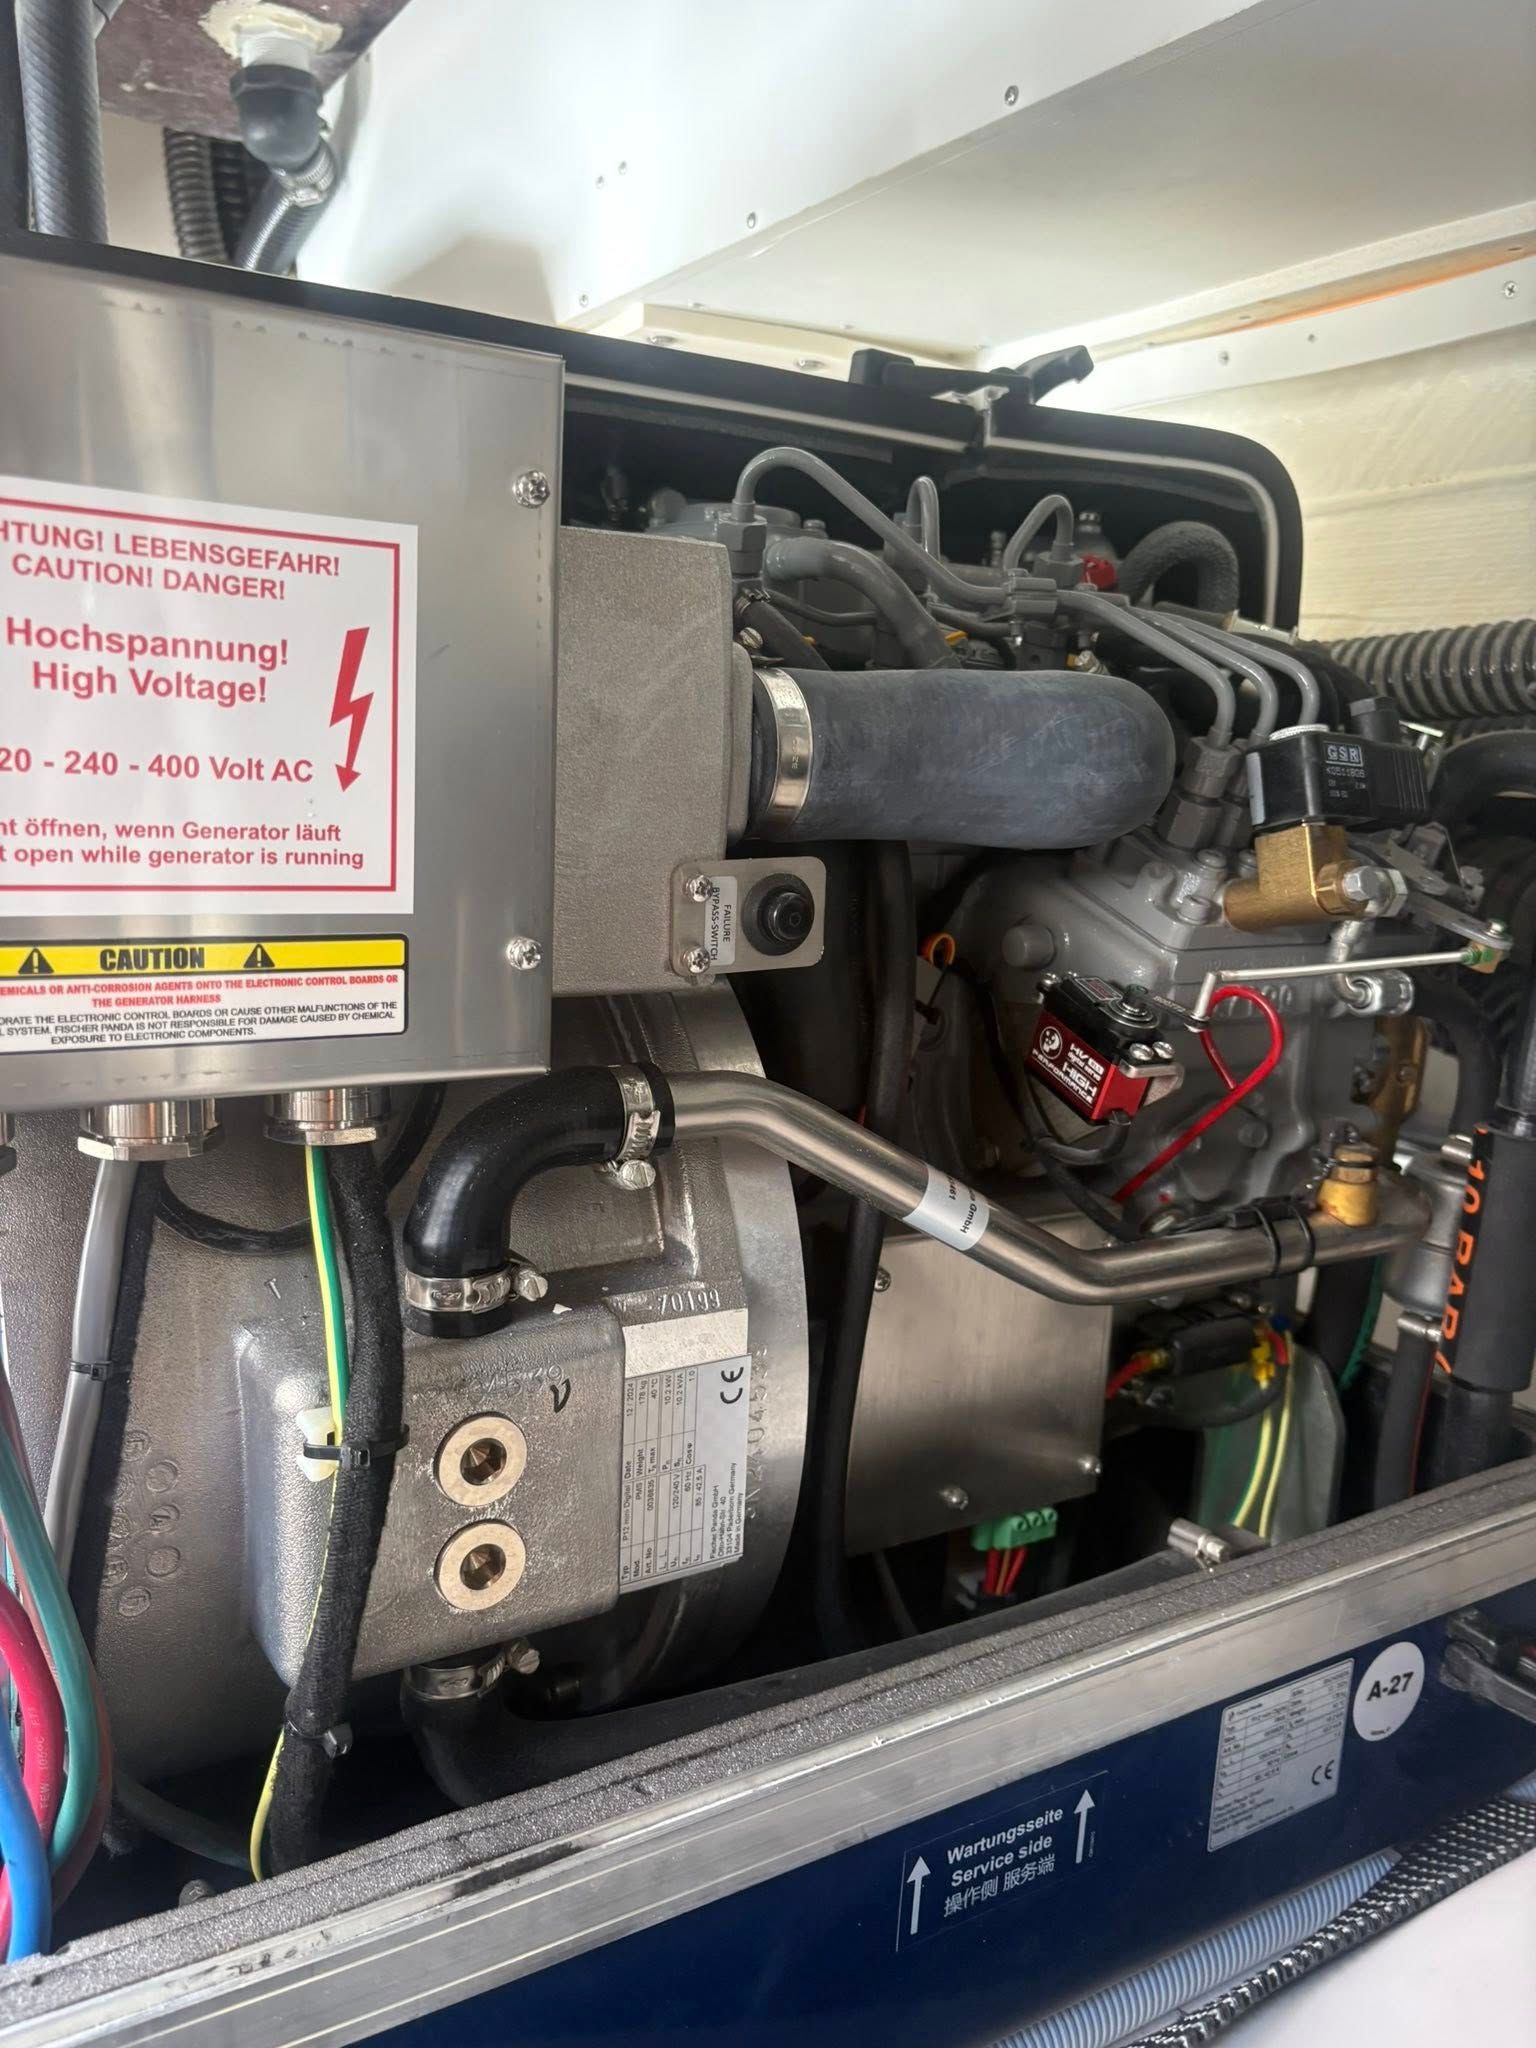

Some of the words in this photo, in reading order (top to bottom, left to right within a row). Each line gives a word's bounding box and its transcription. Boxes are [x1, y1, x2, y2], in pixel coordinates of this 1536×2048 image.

[114, 533, 340, 577] LEBENSGEFAHR!
[12, 553, 152, 588] CAUTION!
[164, 568, 285, 600] DANGER!
[6, 617, 289, 671] Hochspannung!
[32, 661, 117, 700] High
[130, 668, 267, 708] Voltage!
[0, 747, 31, 773] 20
[64, 750, 118, 776] 240
[148, 754, 200, 779] 400
[210, 756, 264, 781] Volt
[271, 759, 313, 783] AC
[1327, 744, 1360, 763] GSR
[25, 818, 108, 841] öffnen,
[115, 823, 175, 839] wenn
[182, 821, 290, 842] Generator
[296, 823, 342, 842] läuft
[14, 847, 74, 867] open
[81, 845, 141, 863] while
[148, 847, 254, 868] generator
[260, 848, 277, 865] is
[284, 849, 363, 869] running
[710, 886, 720, 961] BYPASS-SWITCH
[723, 904, 732, 942] FAILURE
[100, 946, 205, 971] CAUTION
[49, 984, 64, 994] OR
[66, 982, 151, 994] ANTI-CORROSION
[155, 981, 193, 992] AGENTS
[196, 979, 222, 990] ONTO
[225, 979, 243, 989] THE
[246, 977, 303, 988] ELECTRONIC
[305, 976, 347, 986] CONTROL
[350, 974, 384, 985] BOARDS
[386, 974, 398, 984] OR
[92, 998, 113, 1008] THE
[115, 996, 174, 1007] GENERATOR
[176, 994, 221, 1005] HARNESS
[7, 1027, 52, 1037] SYSTEM.
[55, 1024, 98, 1034] FISCHER
[101, 1022, 134, 1032] PANDA
[136, 1022, 145, 1030] IS
[148, 1021, 167, 1030] NOT
[170, 1017, 236, 1028] RESPONSIBLE
[238, 1016, 257, 1026] FOR
[259, 1015, 298, 1025] DAMAGE
[300, 1014, 337, 1024] CAUSED
[338, 1012, 350, 1021] BY
[352, 1011, 395, 1021] CHEMICAL
[35, 1015, 55, 1024] THE
[57, 1012, 122, 1024] ELECTRONIC
[124, 1011, 170, 1021] CONTROL
[172, 1009, 212, 1019] BOARDS
[214, 1008, 229, 1017] OR
[231, 1007, 262, 1017] CAUSE
[264, 1005, 296, 1015] OTHER
[297, 1003, 365, 1014] MALFUNCTIONS
[367, 1003, 379, 1011] OF
[381, 1001, 397, 1010] THE
[51, 1034, 106, 1045] EXPOSURE
[109, 1034, 122, 1042] TO
[124, 1031, 186, 1042] ELECTRONIC
[188, 1027, 256, 1039] COMPONENTS.
[1032, 1048, 1093, 1104] PERFORMANCE
[1062, 1061, 1098, 1097] HIGH
[651, 1390, 657, 1399] 40
[636, 1449, 644, 1476] Weight
[640, 1380, 647, 1389] kg
[1366, 1672, 1414, 1702] A-27
[946, 1807, 1064, 1864] Wartungsseite
[950, 1852, 1014, 1887] Service
[1018, 1834, 1053, 1859] side
[943, 1875, 999, 1918] 操作侧
[1002, 1853, 1055, 1892] 服务端
